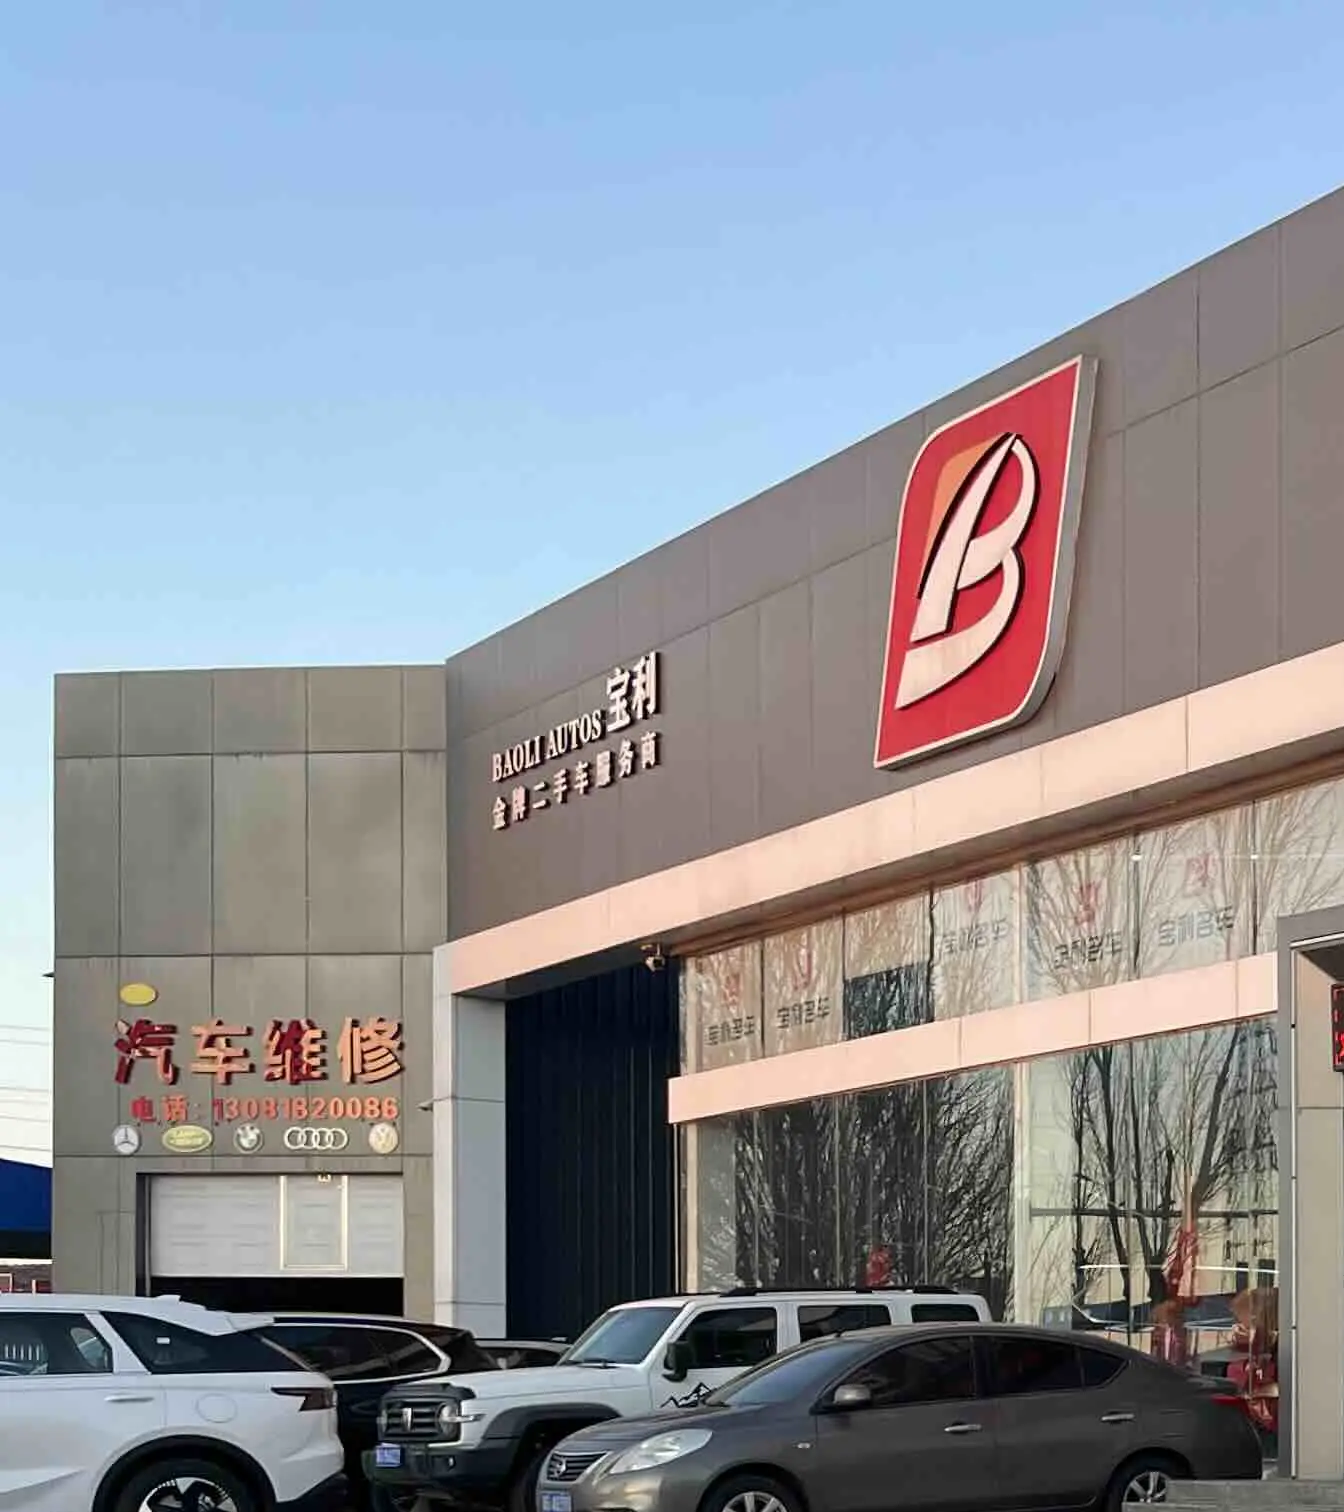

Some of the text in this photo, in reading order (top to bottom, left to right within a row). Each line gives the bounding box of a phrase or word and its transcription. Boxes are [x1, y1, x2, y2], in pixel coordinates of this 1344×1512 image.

[492, 651, 657, 783] BAOLI AUTOS 宝利
[492, 730, 658, 830] 金牌二手车服务商
[115, 1017, 405, 1086] 汽车维修
